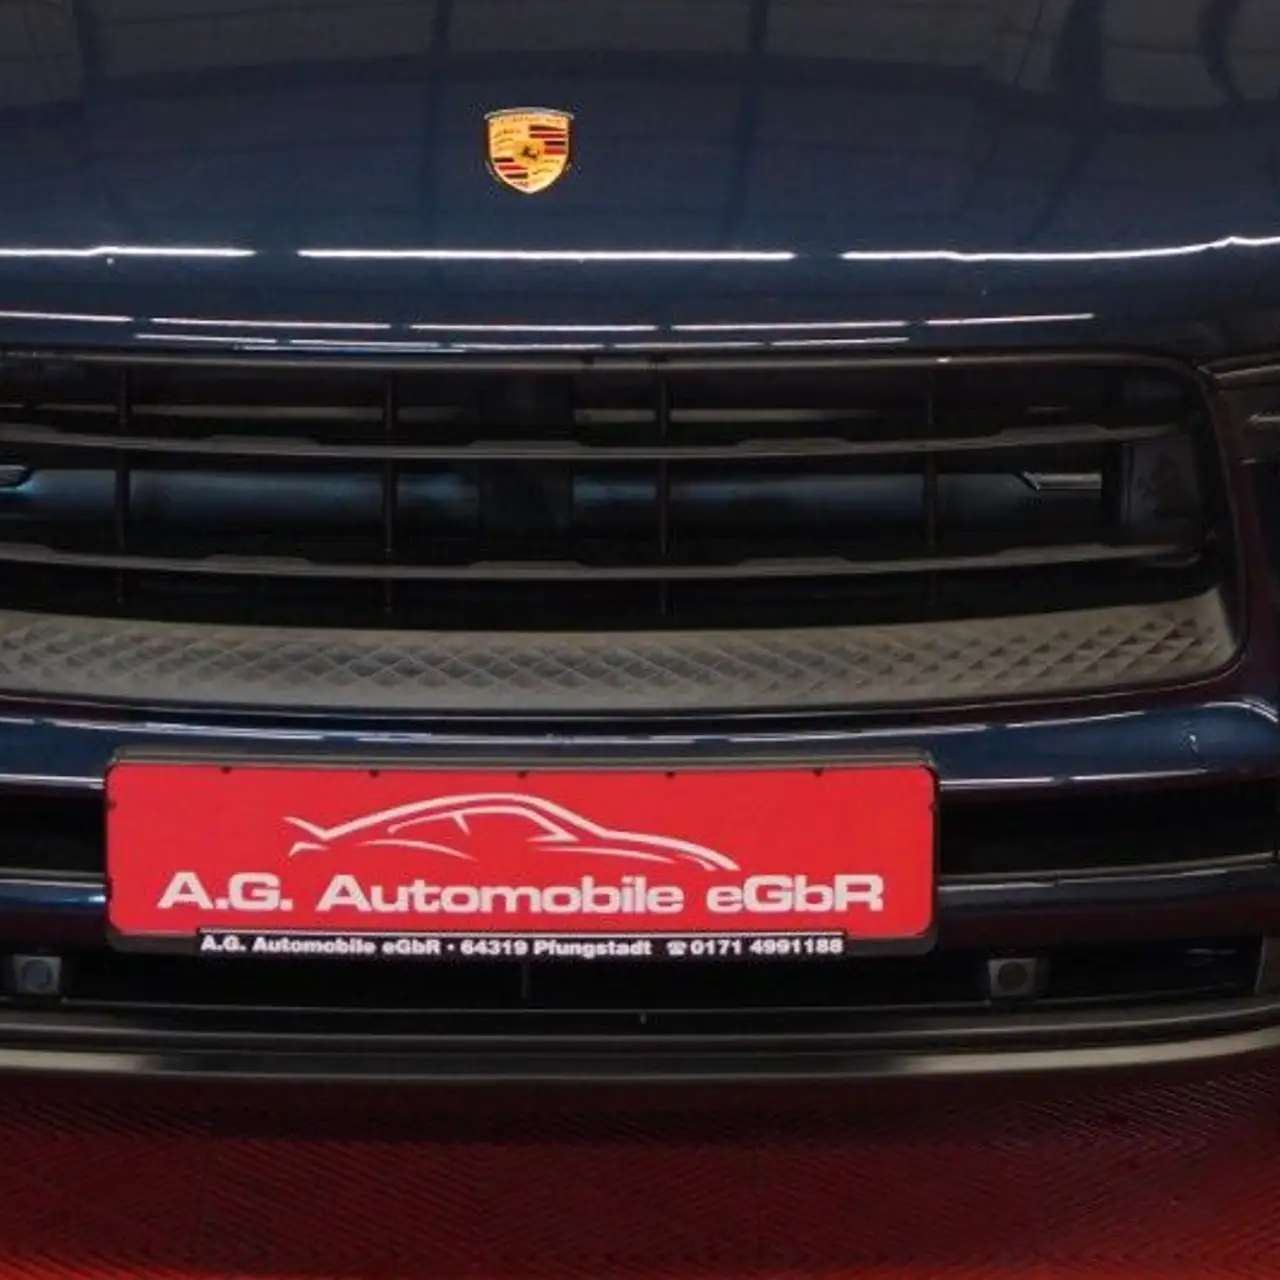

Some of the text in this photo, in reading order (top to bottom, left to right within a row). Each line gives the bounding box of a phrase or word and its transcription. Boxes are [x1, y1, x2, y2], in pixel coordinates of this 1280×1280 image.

[157, 871, 883, 914] A.G. Automobile eGbR
[200, 936, 844, 960] A.G. Automobile eGbR 64319 Pfungstadt 0171 4991188
